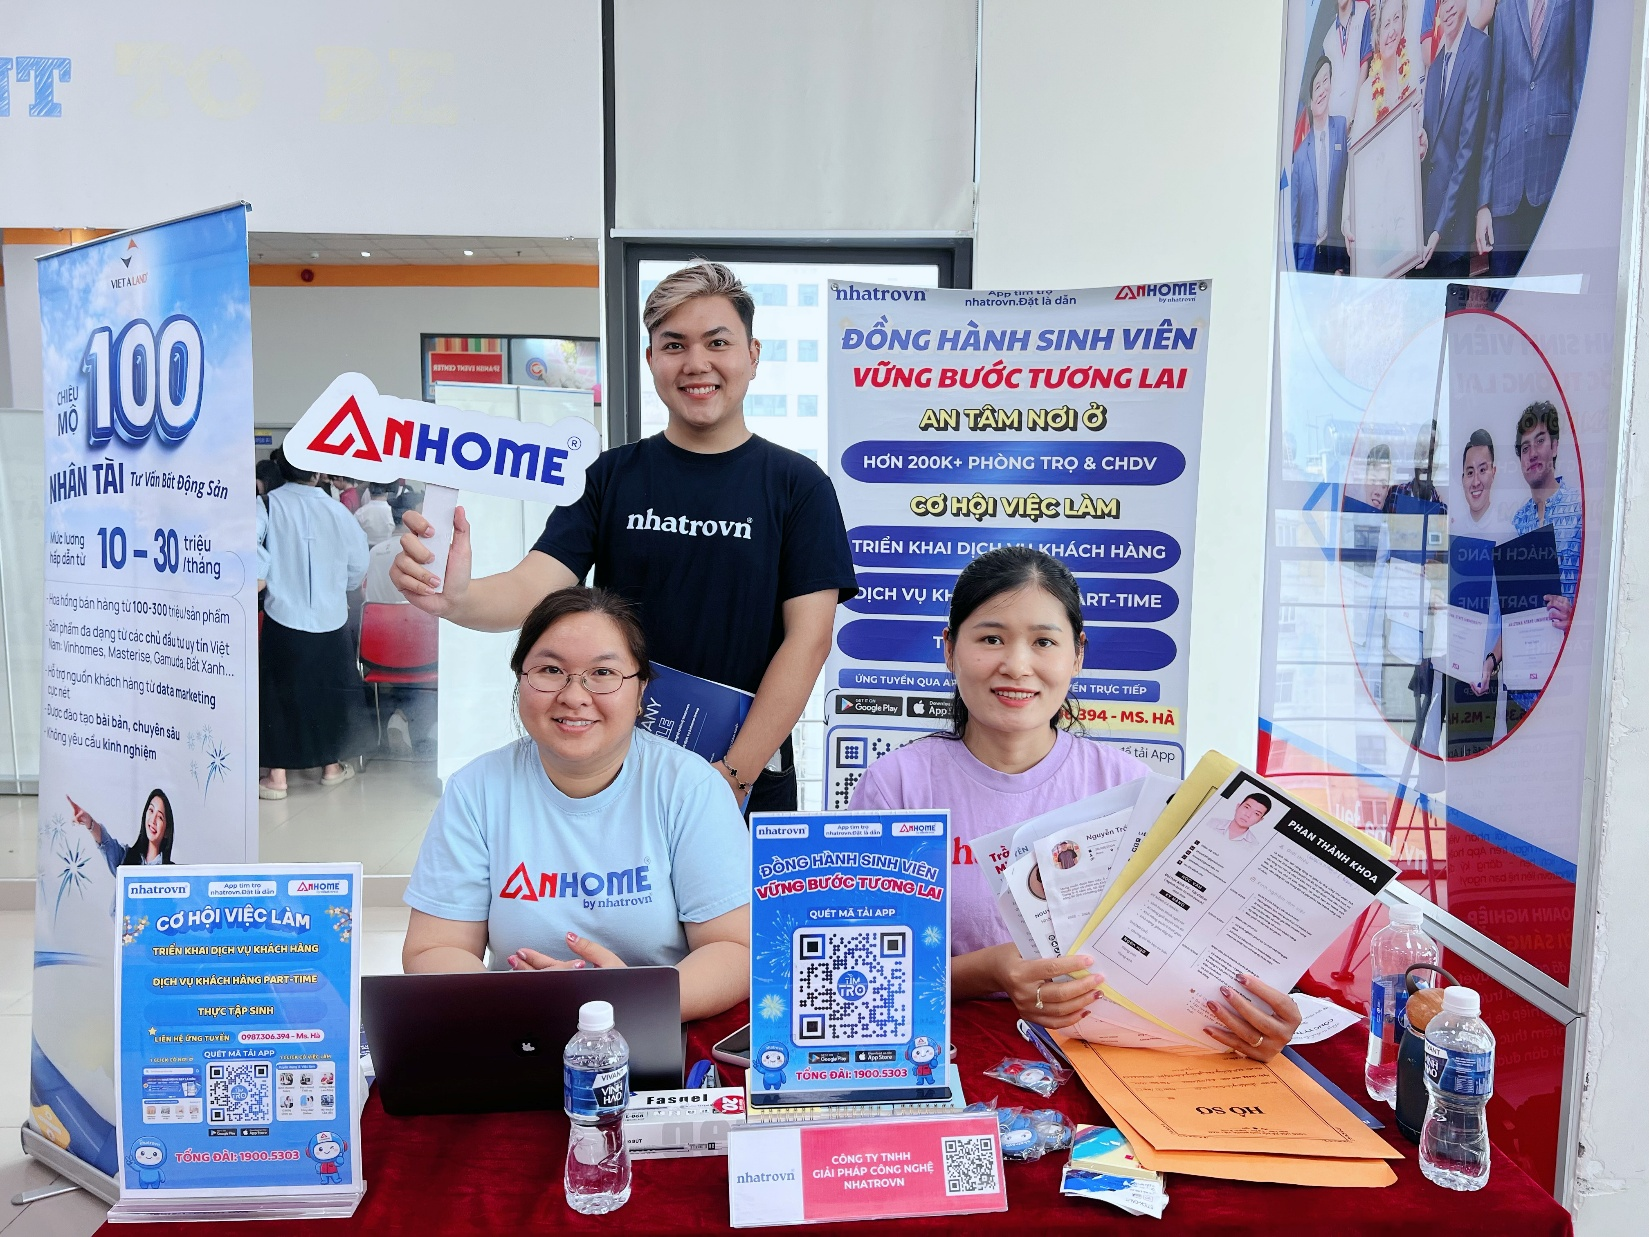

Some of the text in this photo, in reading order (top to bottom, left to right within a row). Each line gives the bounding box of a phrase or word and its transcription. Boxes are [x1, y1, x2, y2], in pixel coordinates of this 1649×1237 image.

[1042, 295, 1053, 305] là
[1054, 294, 1077, 305] dẫn
[841, 315, 1198, 352] ĐỒNG HÀNH SINH VIÊN
[84, 314, 205, 447] 100
[853, 359, 1188, 390] VỮNG BƯỚC TƯƠNG LAI
[58, 405, 79, 436] MỘ
[919, 402, 1108, 431] AN TÂM NƠI Ở
[863, 451, 1158, 475] HƠN 200K+ PHÒNG TRỌ & CHDV
[50, 457, 228, 505] NHÂN TÀI Tư Vấn Bất Động Sản
[910, 492, 1121, 522] CƠ HỘI VIỆC LÀM
[97, 526, 127, 570] 10
[153, 527, 179, 574] 30
[183, 535, 211, 556] triệu
[852, 536, 903, 555] TRIỂN
[907, 540, 952, 556] KHAI
[1039, 537, 1106, 558] KHÁCH
[1110, 540, 1166, 560] HÀNG
[183, 557, 221, 580] /tháng
[855, 587, 897, 603] DỊCH
[902, 588, 927, 604] VỤ
[1079, 593, 1162, 609] ART-TIME
[79, 596, 230, 625] bán hàng từ 100-300 phẩm
[855, 673, 880, 685] ỨNG
[883, 673, 916, 686] TUYỂN
[917, 677, 941, 688] QUA
[1090, 684, 1120, 696] TRỰC
[1122, 683, 1147, 695] TIẾP
[855, 702, 899, 715] Google Play
[929, 705, 947, 716] App
[1120, 710, 1149, 724] MS.
[1152, 709, 1175, 726] HÀ
[102, 737, 157, 762] kinh nghiệm
[1134, 747, 1175, 763] tải App
[1288, 819, 1379, 884] PHAN THÀNH KHOA
[760, 850, 938, 881] ĐỒNG HÀNH SINH VIÊN
[755, 873, 943, 902] VỮNG BƯỚC TƯƠNG LAI
[583, 896, 653, 909] by nhatrovn
[156, 903, 311, 933] CƠ HỘI VIỆC LÀM
[810, 908, 895, 920] QUÉT MÃ TẢI APP
[153, 941, 319, 957] TRIỂN KHAI DỊCH VỤ KHÁCH HÀNG
[153, 973, 318, 988] DỊCH VỤ KHÁCH HÀNG PART-TIME
[198, 1004, 275, 1019] THỰC TẬP SINH
[204, 1049, 226, 1061] QUÉT
[257, 1050, 275, 1059] APP
[796, 1066, 908, 1081] TỔNG ĐÀI: 1900.5303
[176, 1147, 301, 1163] TỔNG ĐÀI: 1900.5303
[832, 1152, 911, 1165] CÔNG TY TNHH
[813, 1161, 934, 1179] GIẢI PHÁP CÔNG NGHỆ
[844, 1177, 905, 1190] NHATROVN
